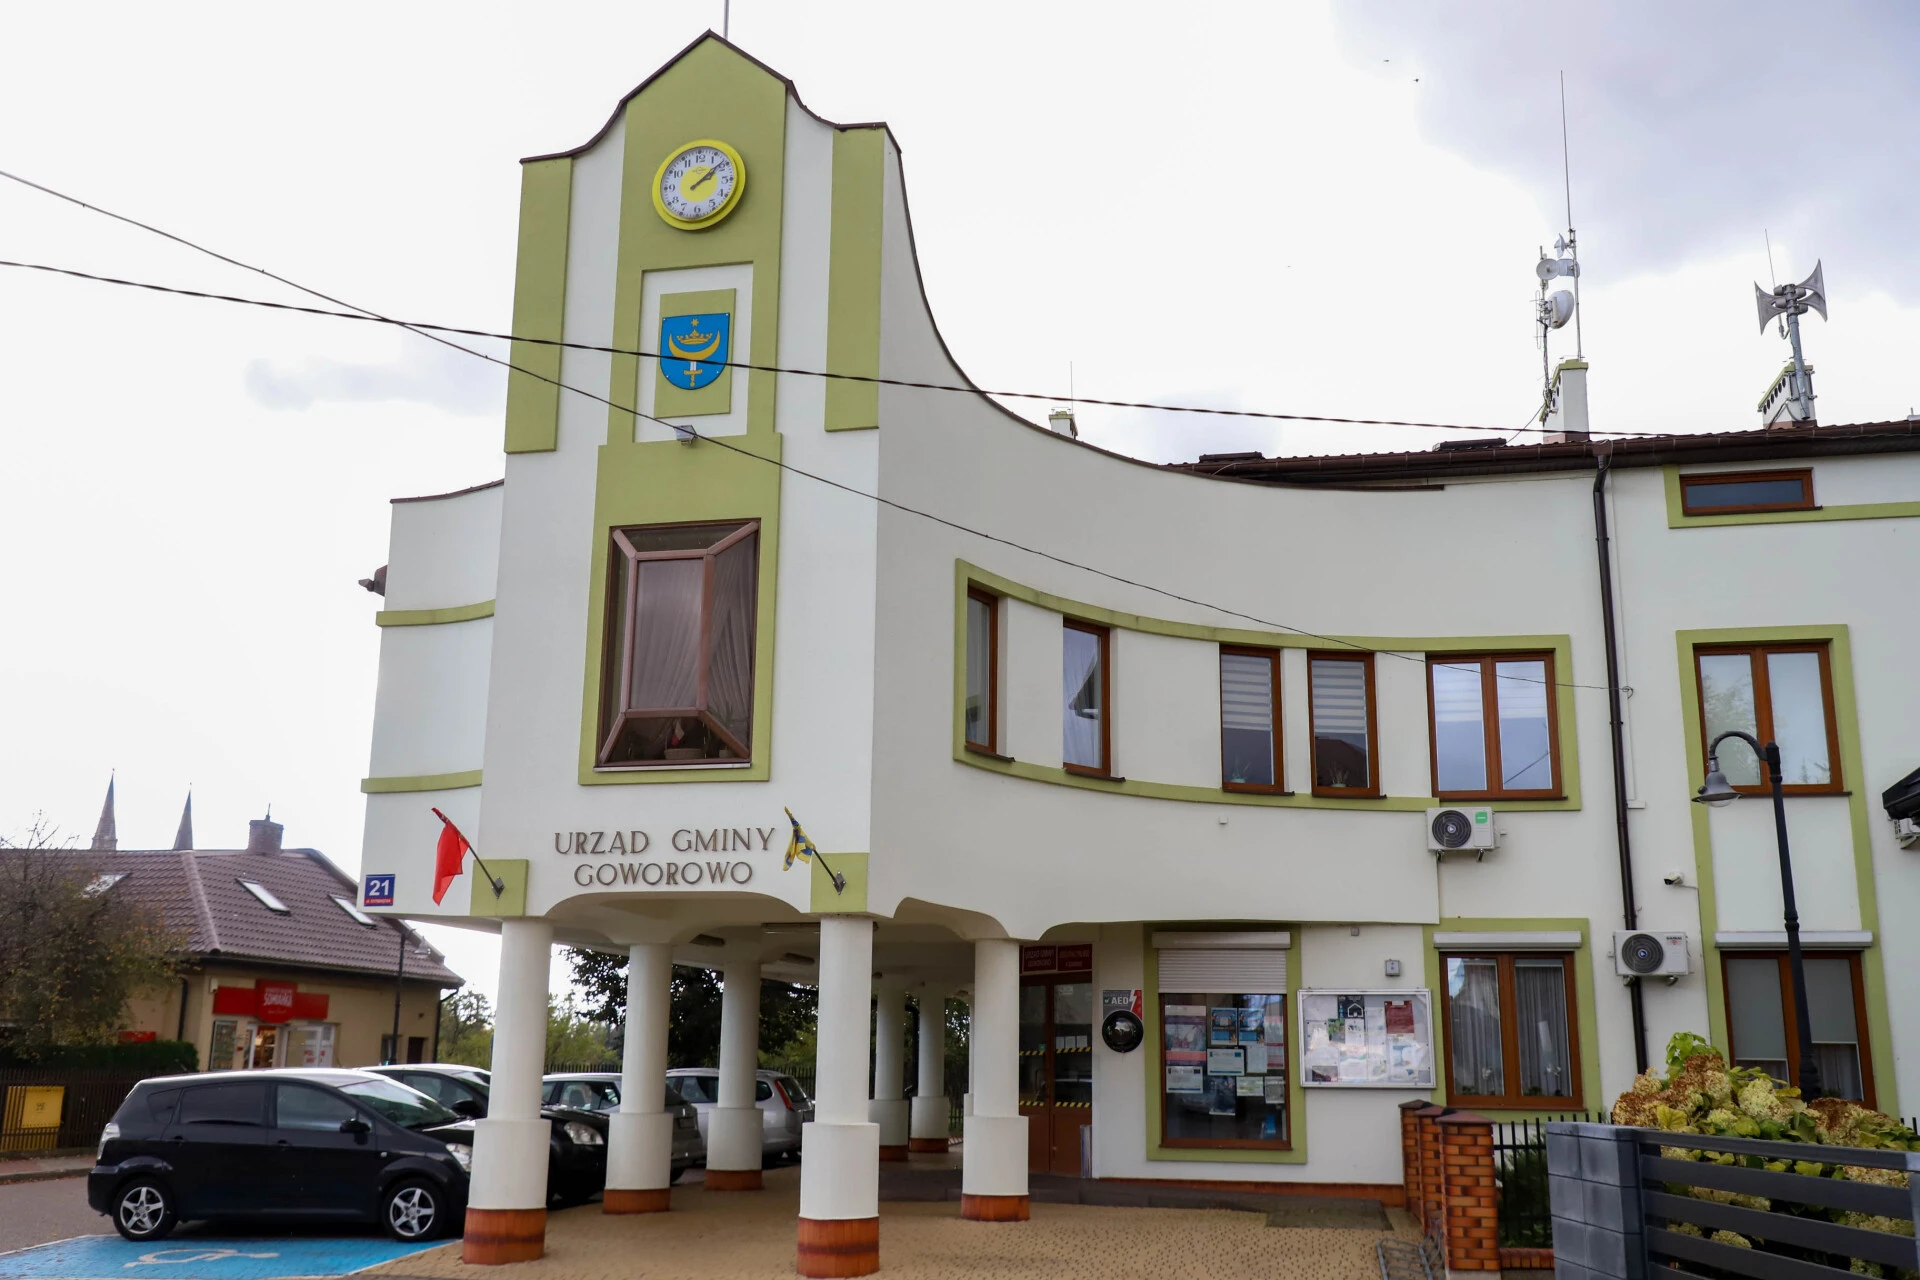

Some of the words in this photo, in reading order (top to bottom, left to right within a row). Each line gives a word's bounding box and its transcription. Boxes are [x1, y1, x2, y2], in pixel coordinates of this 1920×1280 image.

[696, 155, 705, 163] 12
[684, 160, 691, 168] 11
[673, 170, 683, 178] 10
[721, 176, 729, 184] 3
[668, 184, 675, 192] 9
[717, 189, 723, 197] 4
[672, 196, 679, 204] 8
[709, 199, 716, 207] 5
[681, 203, 687, 211] 7
[694, 205, 701, 213] 6
[554, 830, 650, 856] URZĄD
[671, 827, 775, 852] GMINY
[574, 861, 753, 886] GOWOROWO
[369, 879, 390, 896] 21
[1111, 996, 1129, 1005] AED
